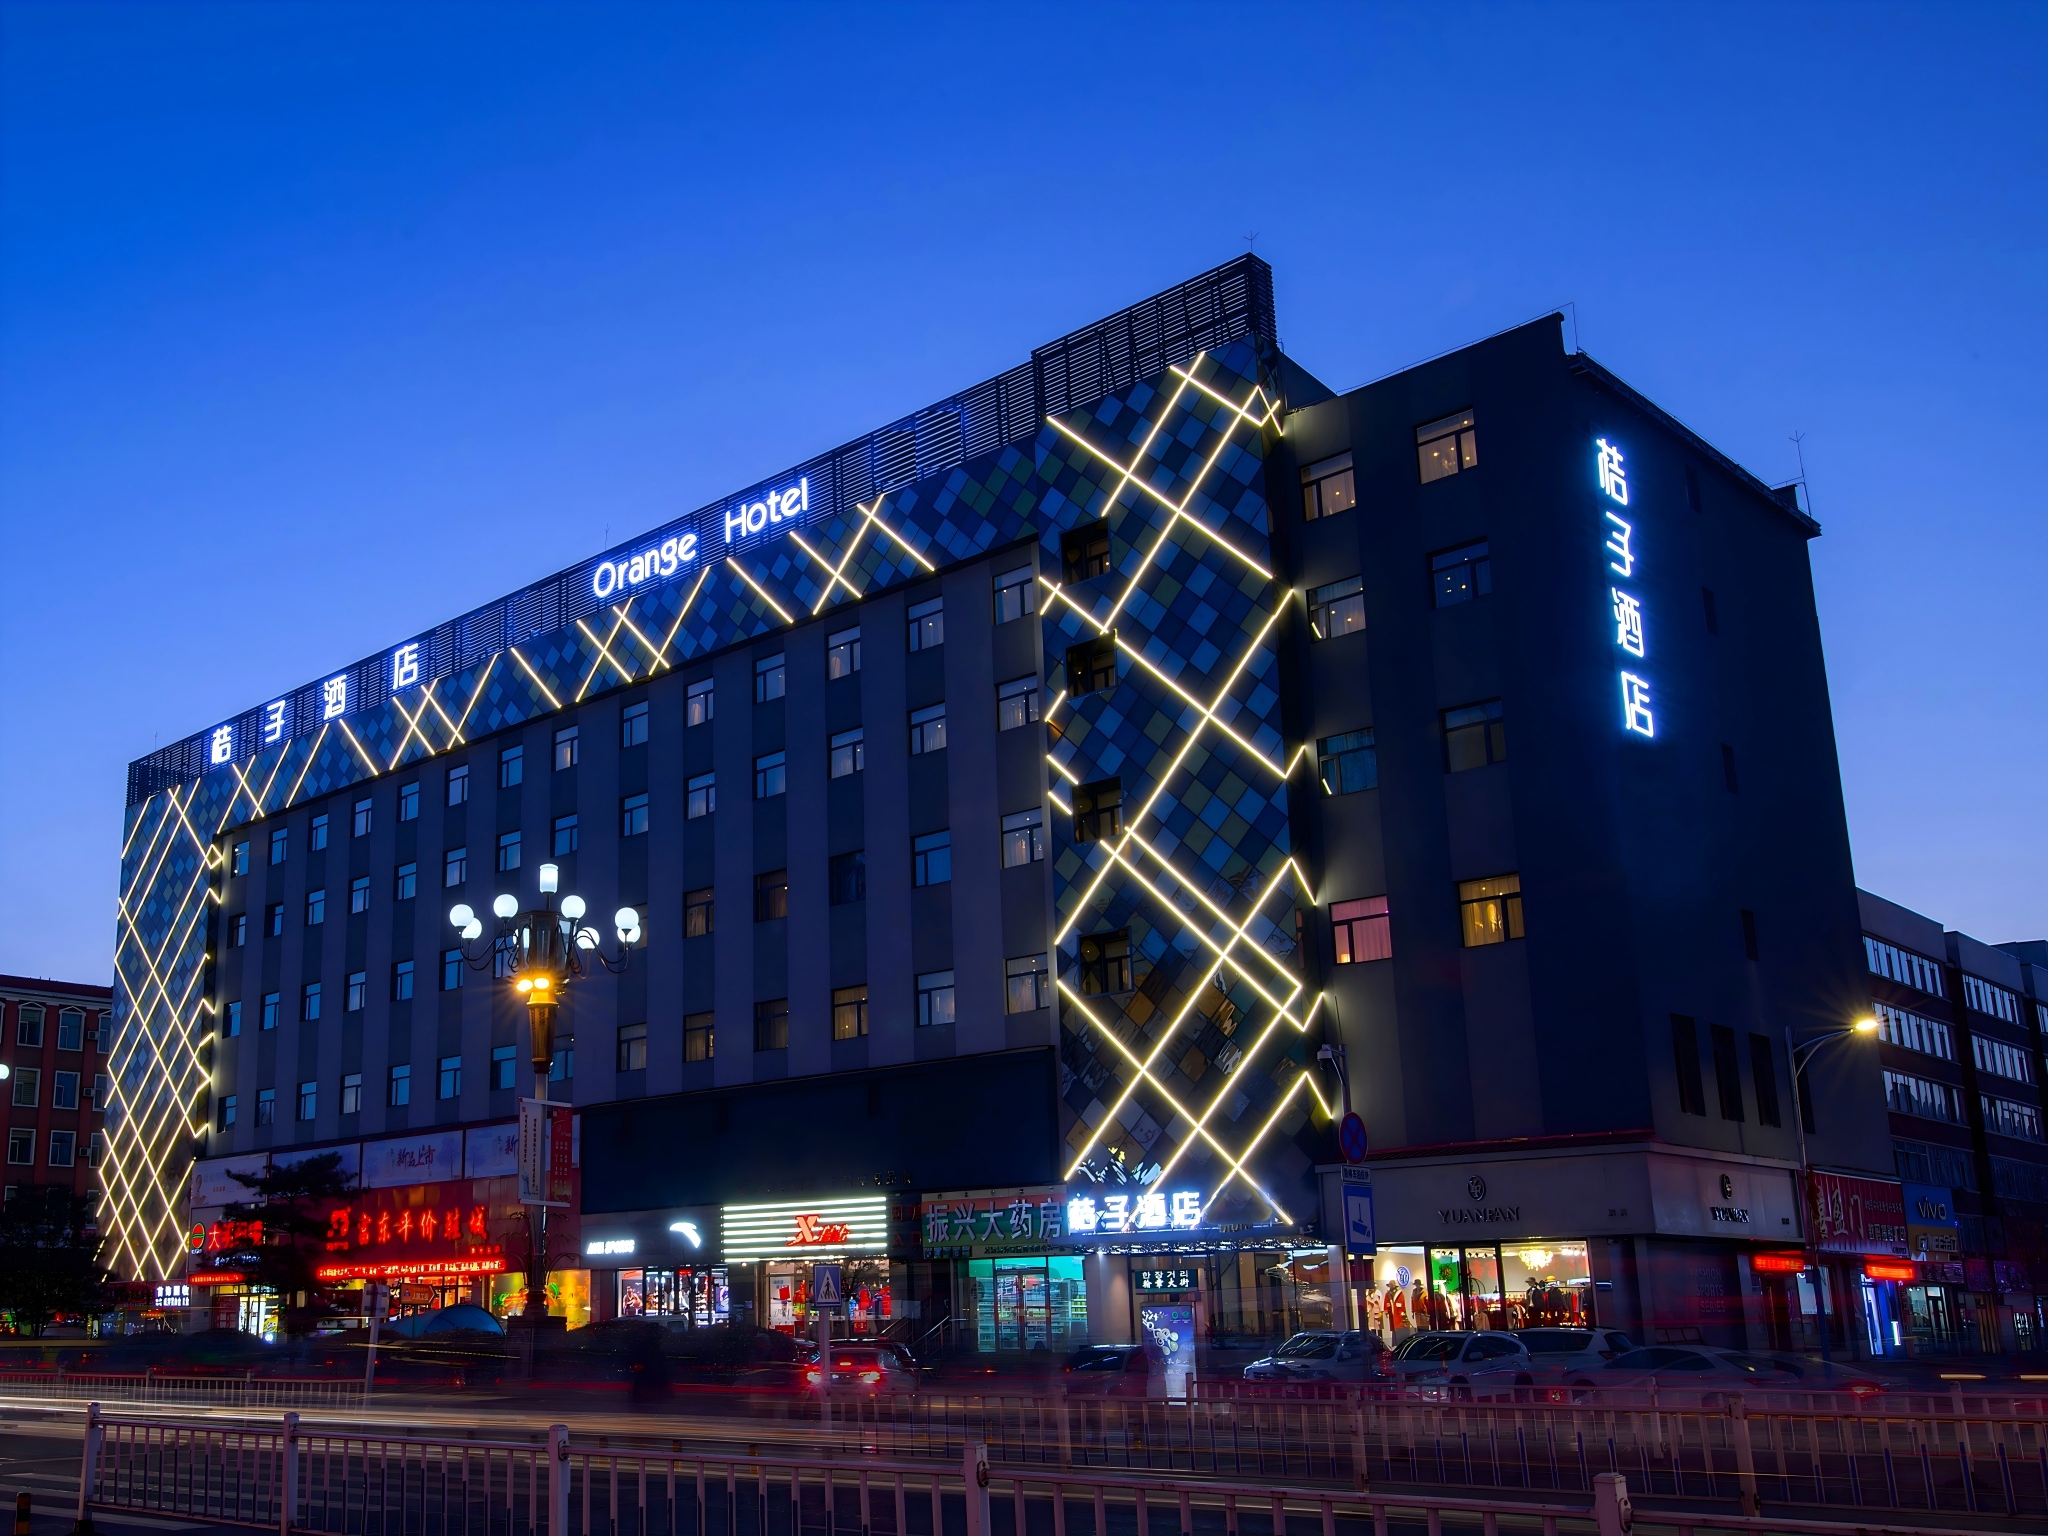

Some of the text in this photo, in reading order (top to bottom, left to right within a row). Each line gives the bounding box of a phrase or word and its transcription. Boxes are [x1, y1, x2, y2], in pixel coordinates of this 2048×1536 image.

[593, 477, 808, 598] Orange Hotel
[1596, 438, 1654, 738] 桔子酒店
[210, 643, 419, 765] 桔子酒店
[396, 1144, 436, 1170] 新品上市
[926, 1197, 1063, 1243] 振兴大药房
[1067, 1191, 1201, 1231] 桔子酒店
[1438, 1206, 1520, 1223] YUANFAN
[1916, 1196, 1947, 1221] vivo
